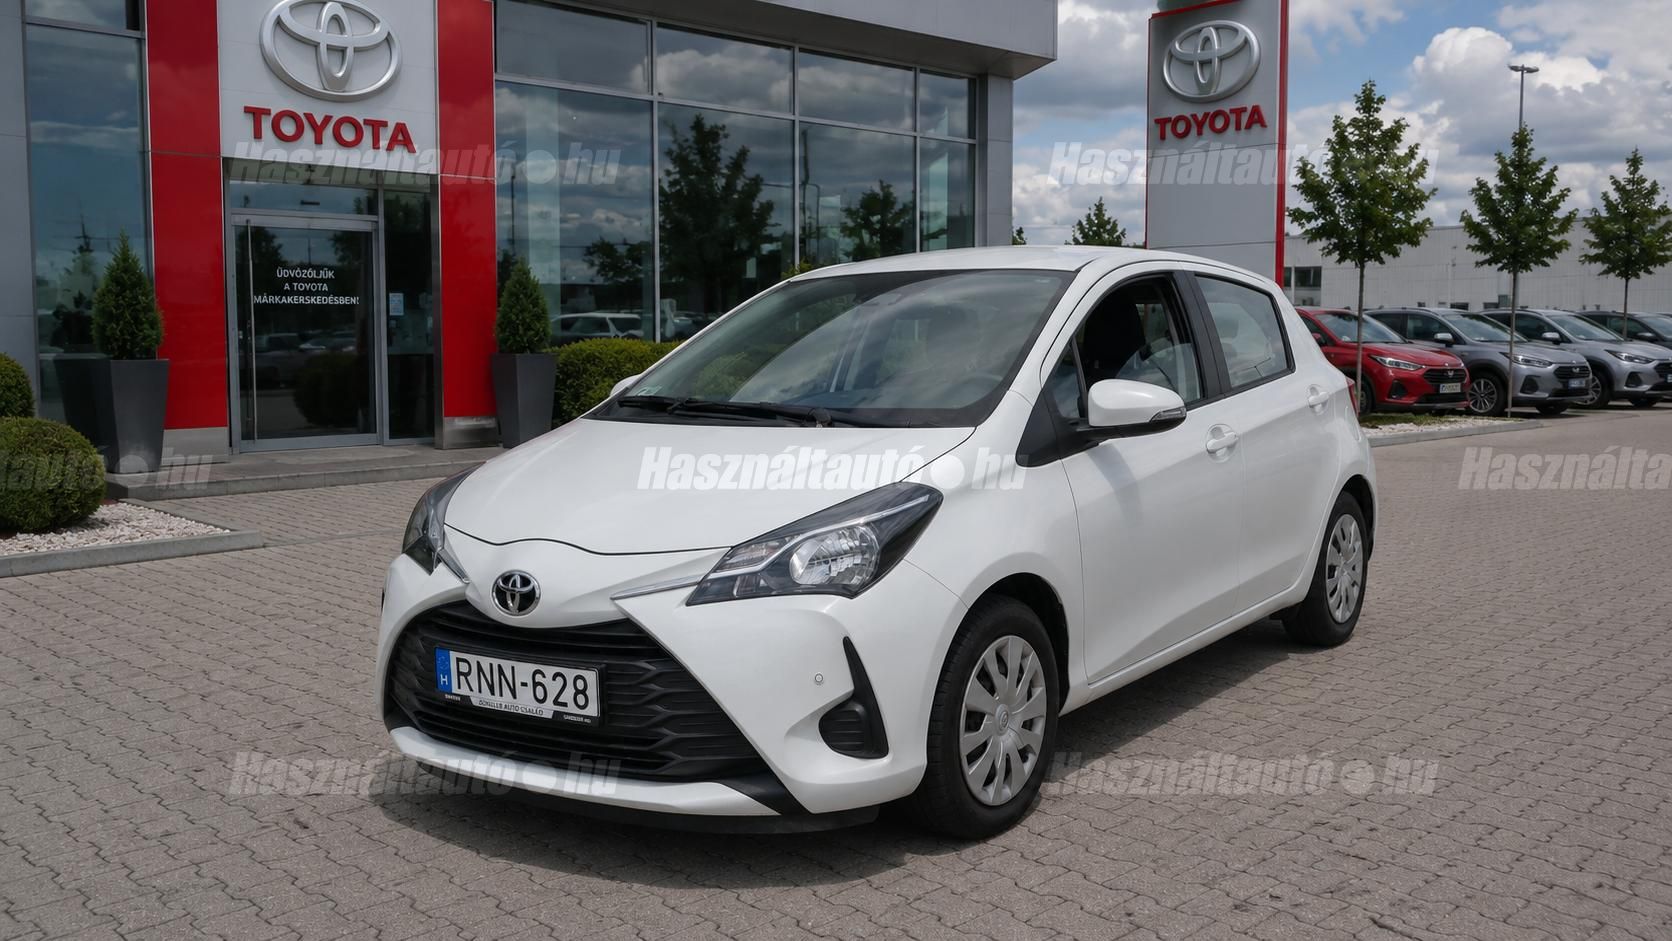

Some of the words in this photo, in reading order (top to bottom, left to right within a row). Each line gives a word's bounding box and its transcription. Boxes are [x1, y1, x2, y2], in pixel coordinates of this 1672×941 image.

[243, 105, 417, 154] TOYOTA
[1153, 104, 1268, 141] TOYOTA
[283, 283, 291, 291] A
[292, 282, 329, 292] TOYOTA
[440, 674, 449, 686] H
[455, 656, 590, 711] RNN-628
